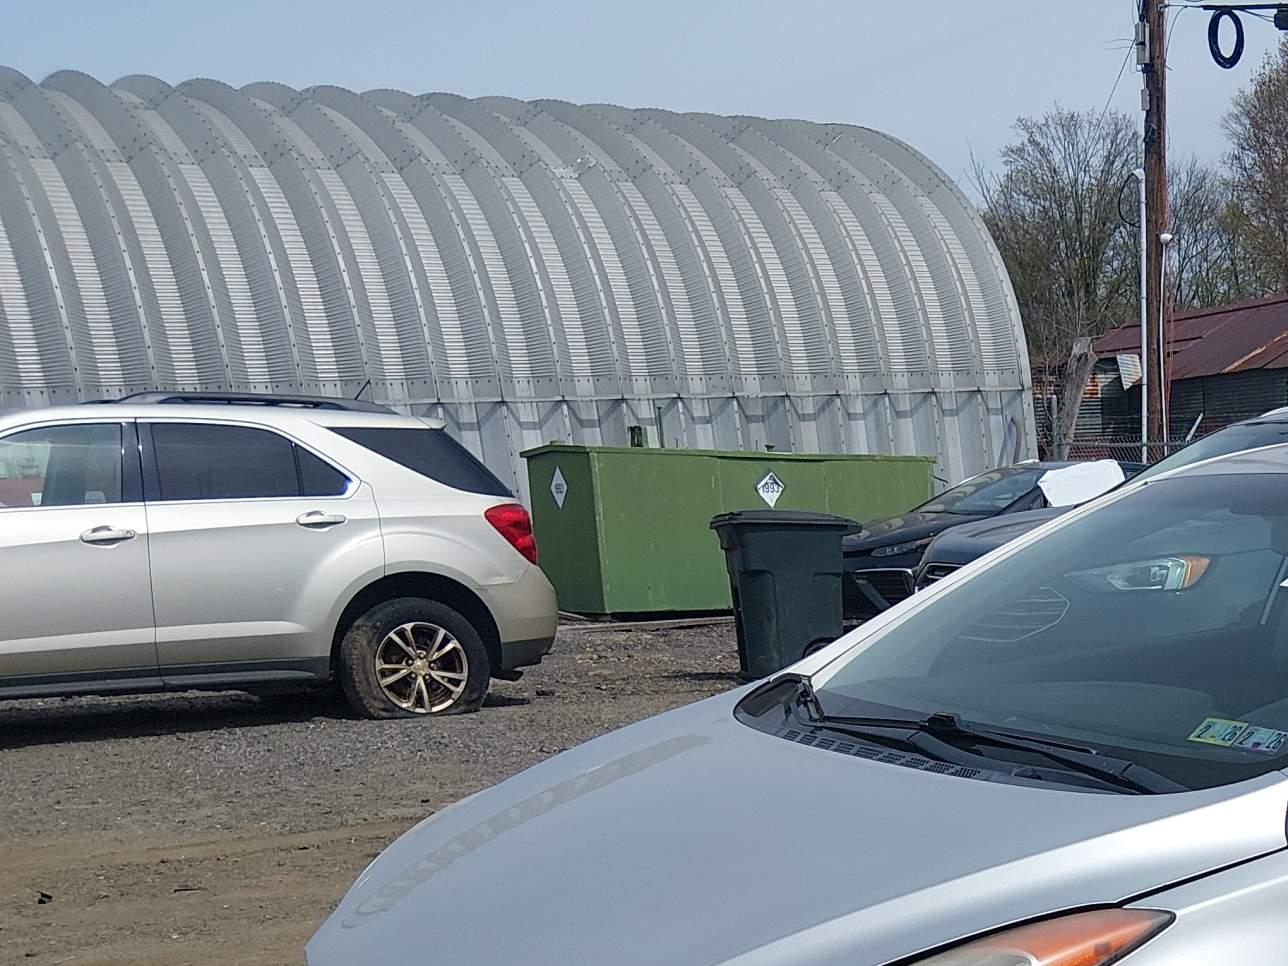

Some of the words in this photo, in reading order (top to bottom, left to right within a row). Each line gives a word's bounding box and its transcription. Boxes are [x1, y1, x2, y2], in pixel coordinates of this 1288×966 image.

[761, 482, 780, 494] 1993
[1195, 724, 1212, 739] 2
[1221, 725, 1243, 742] 26
[1238, 731, 1255, 745] 2
[1265, 732, 1288, 750] 26
